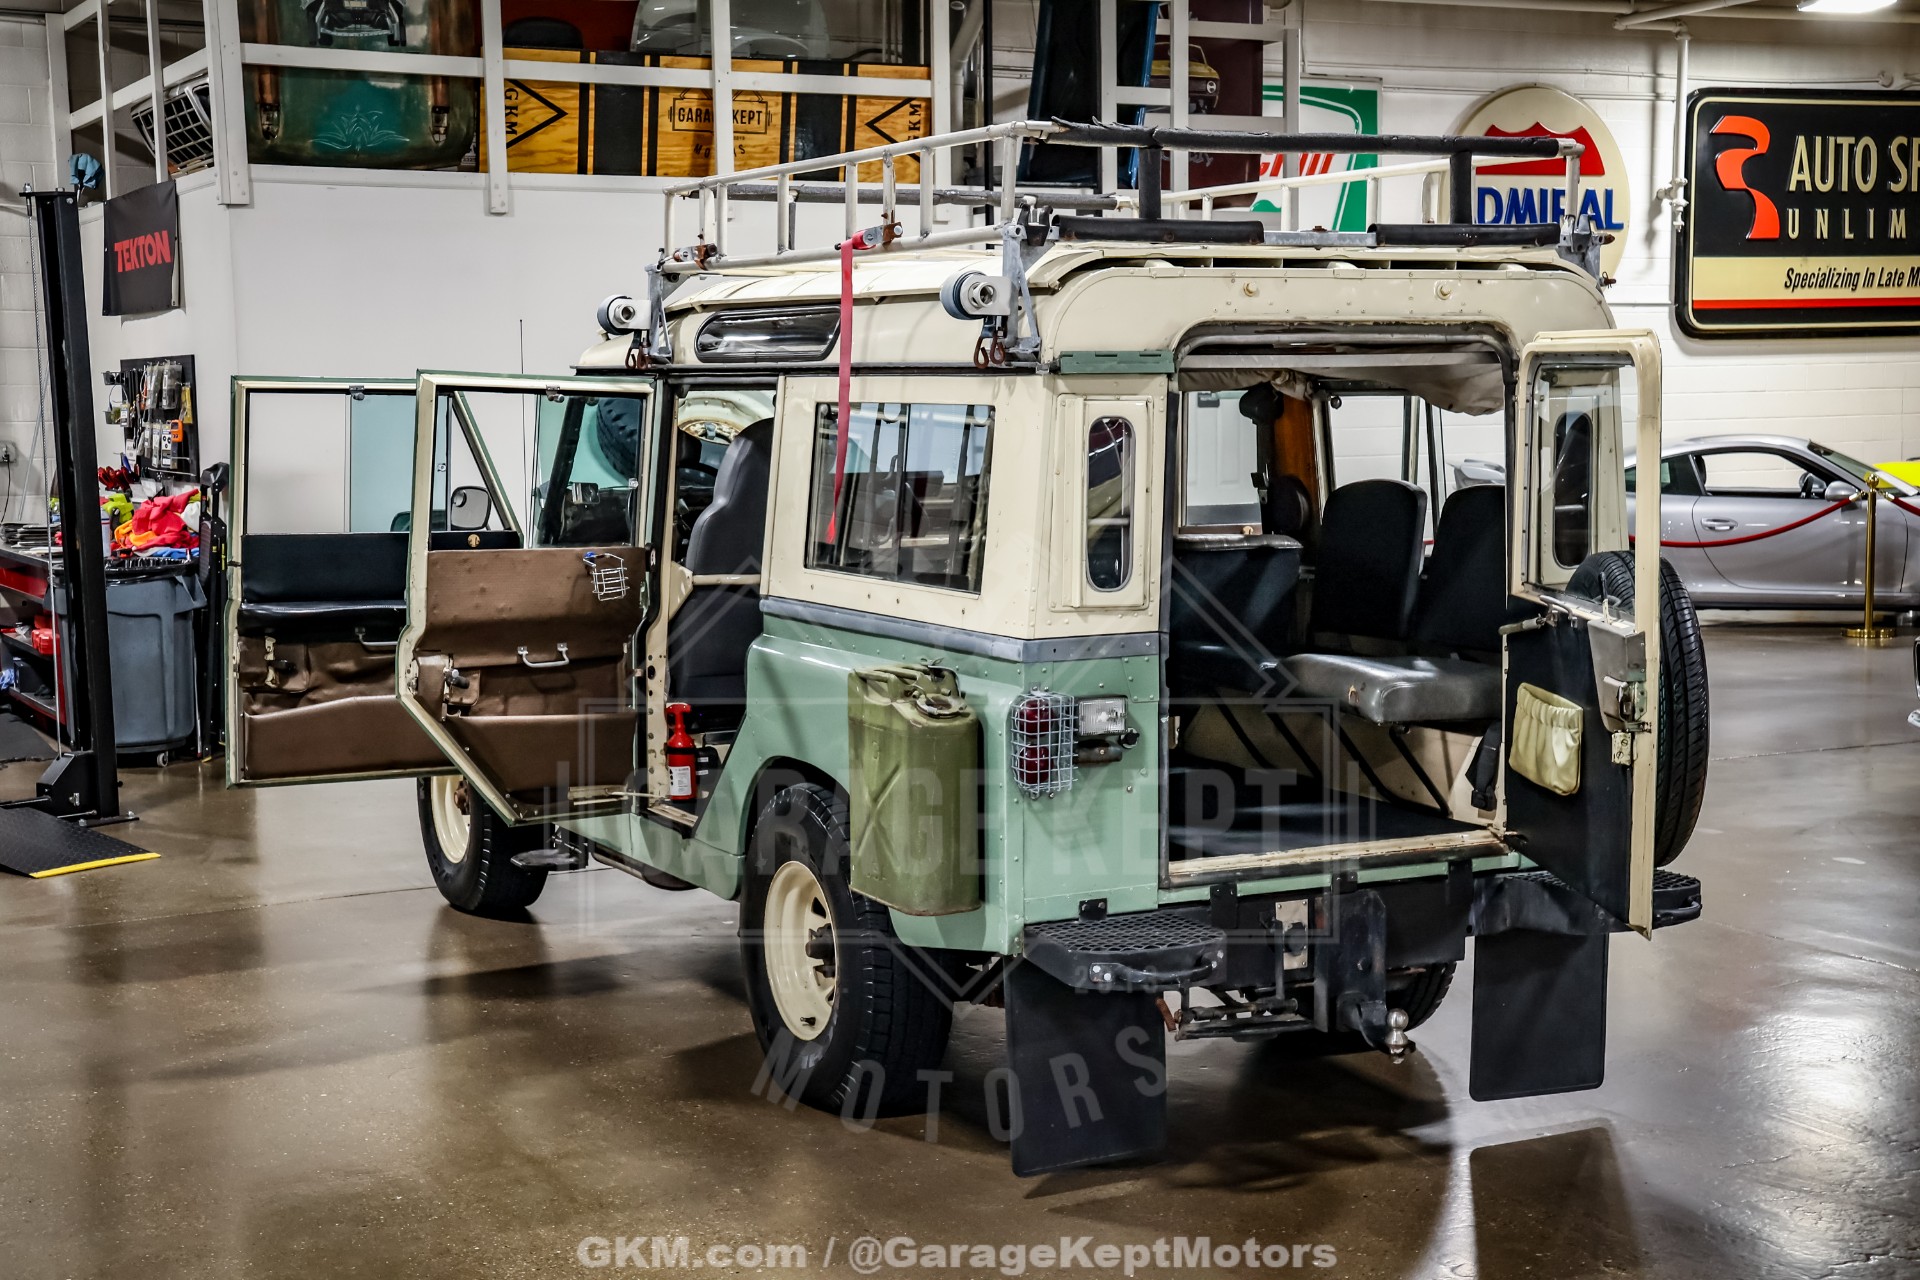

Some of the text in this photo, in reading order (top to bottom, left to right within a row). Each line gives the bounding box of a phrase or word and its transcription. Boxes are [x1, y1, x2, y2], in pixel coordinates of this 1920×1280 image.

[504, 87, 519, 135] GKM
[678, 107, 713, 123] GARA
[1789, 135, 1878, 193] AUTO
[1787, 208, 1907, 240] UNLIM
[114, 230, 171, 273] TEKTON
[1784, 267, 1861, 292] Specializing
[1862, 266, 1876, 288] In
[1877, 266, 1905, 288] Late
